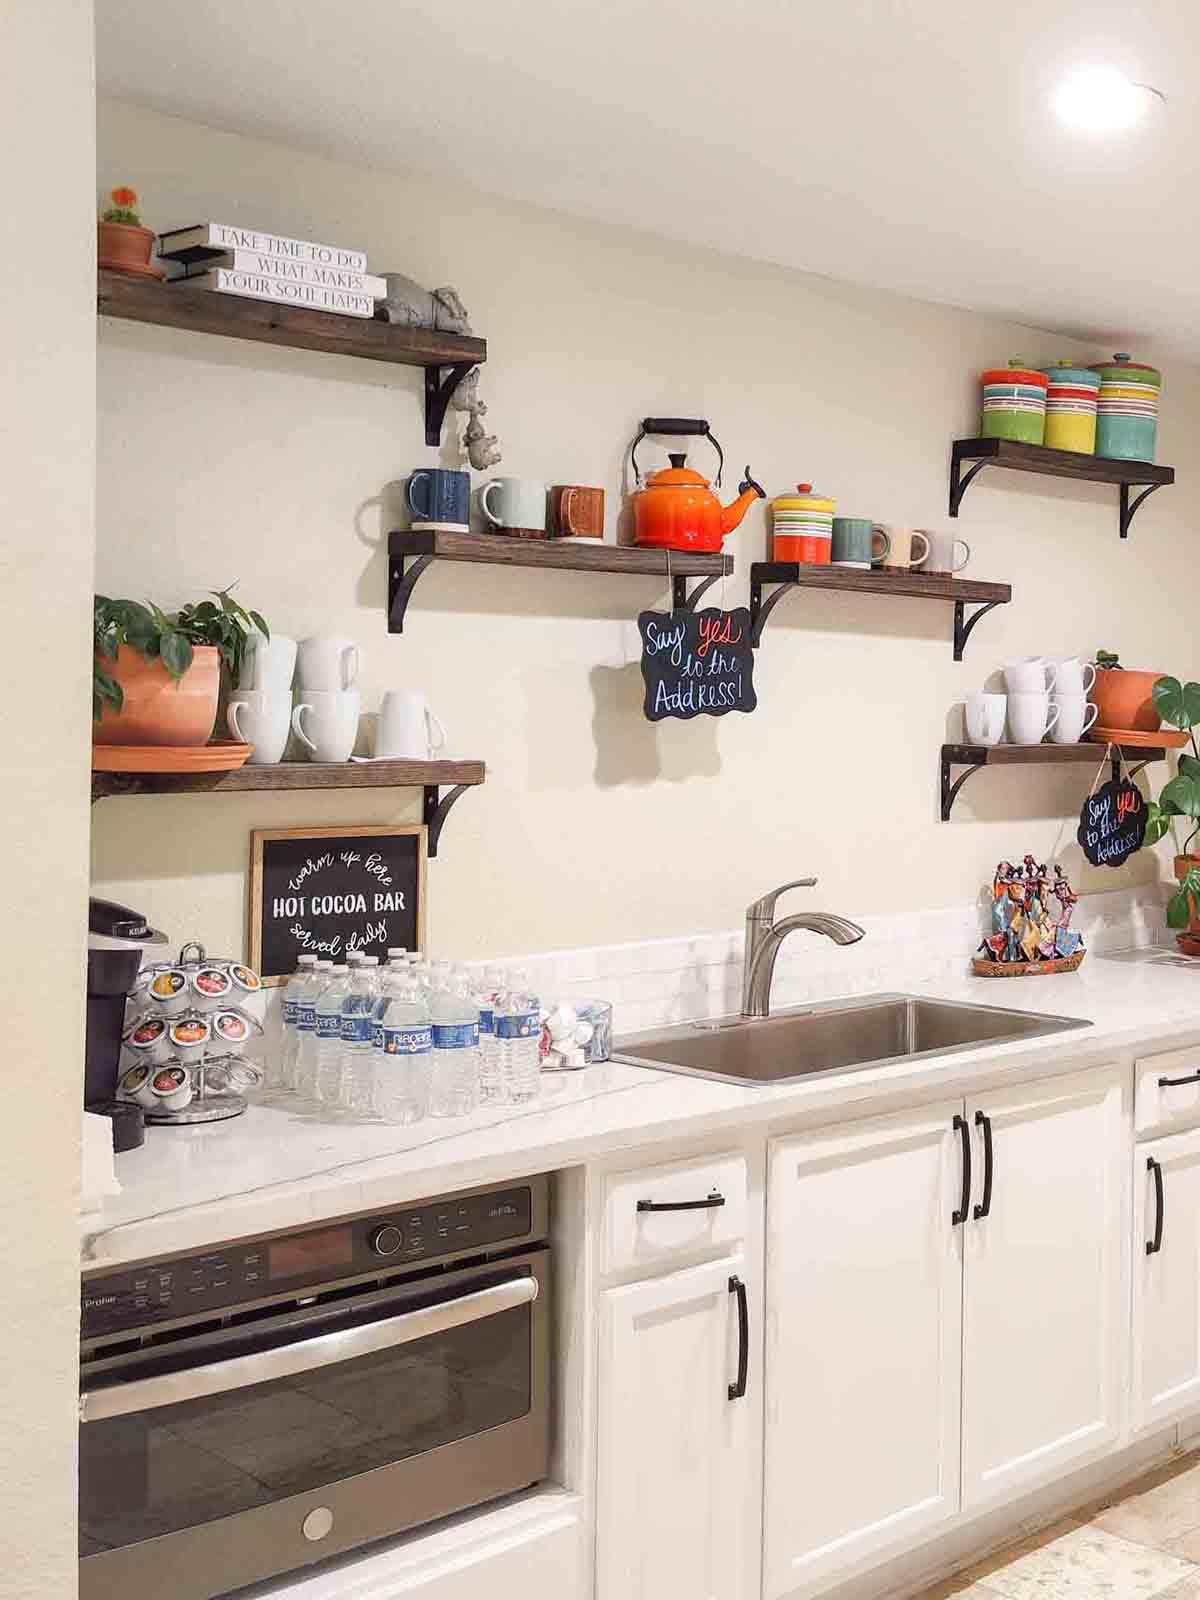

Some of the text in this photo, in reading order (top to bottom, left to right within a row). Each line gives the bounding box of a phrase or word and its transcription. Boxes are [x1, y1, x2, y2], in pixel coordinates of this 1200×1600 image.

[218, 227, 363, 269] TAKE TIME TO DO
[256, 256, 364, 289] WHAT MAKES
[221, 272, 371, 312] YOUR SOUL HAPPY
[645, 615, 743, 667] Say yes
[681, 648, 739, 678] to the
[1088, 794, 1111, 827] Say
[1087, 830, 1099, 848] to
[288, 850, 393, 891] warm up here
[272, 891, 407, 919] HOT COCOA BAR
[289, 917, 389, 956] served daily
